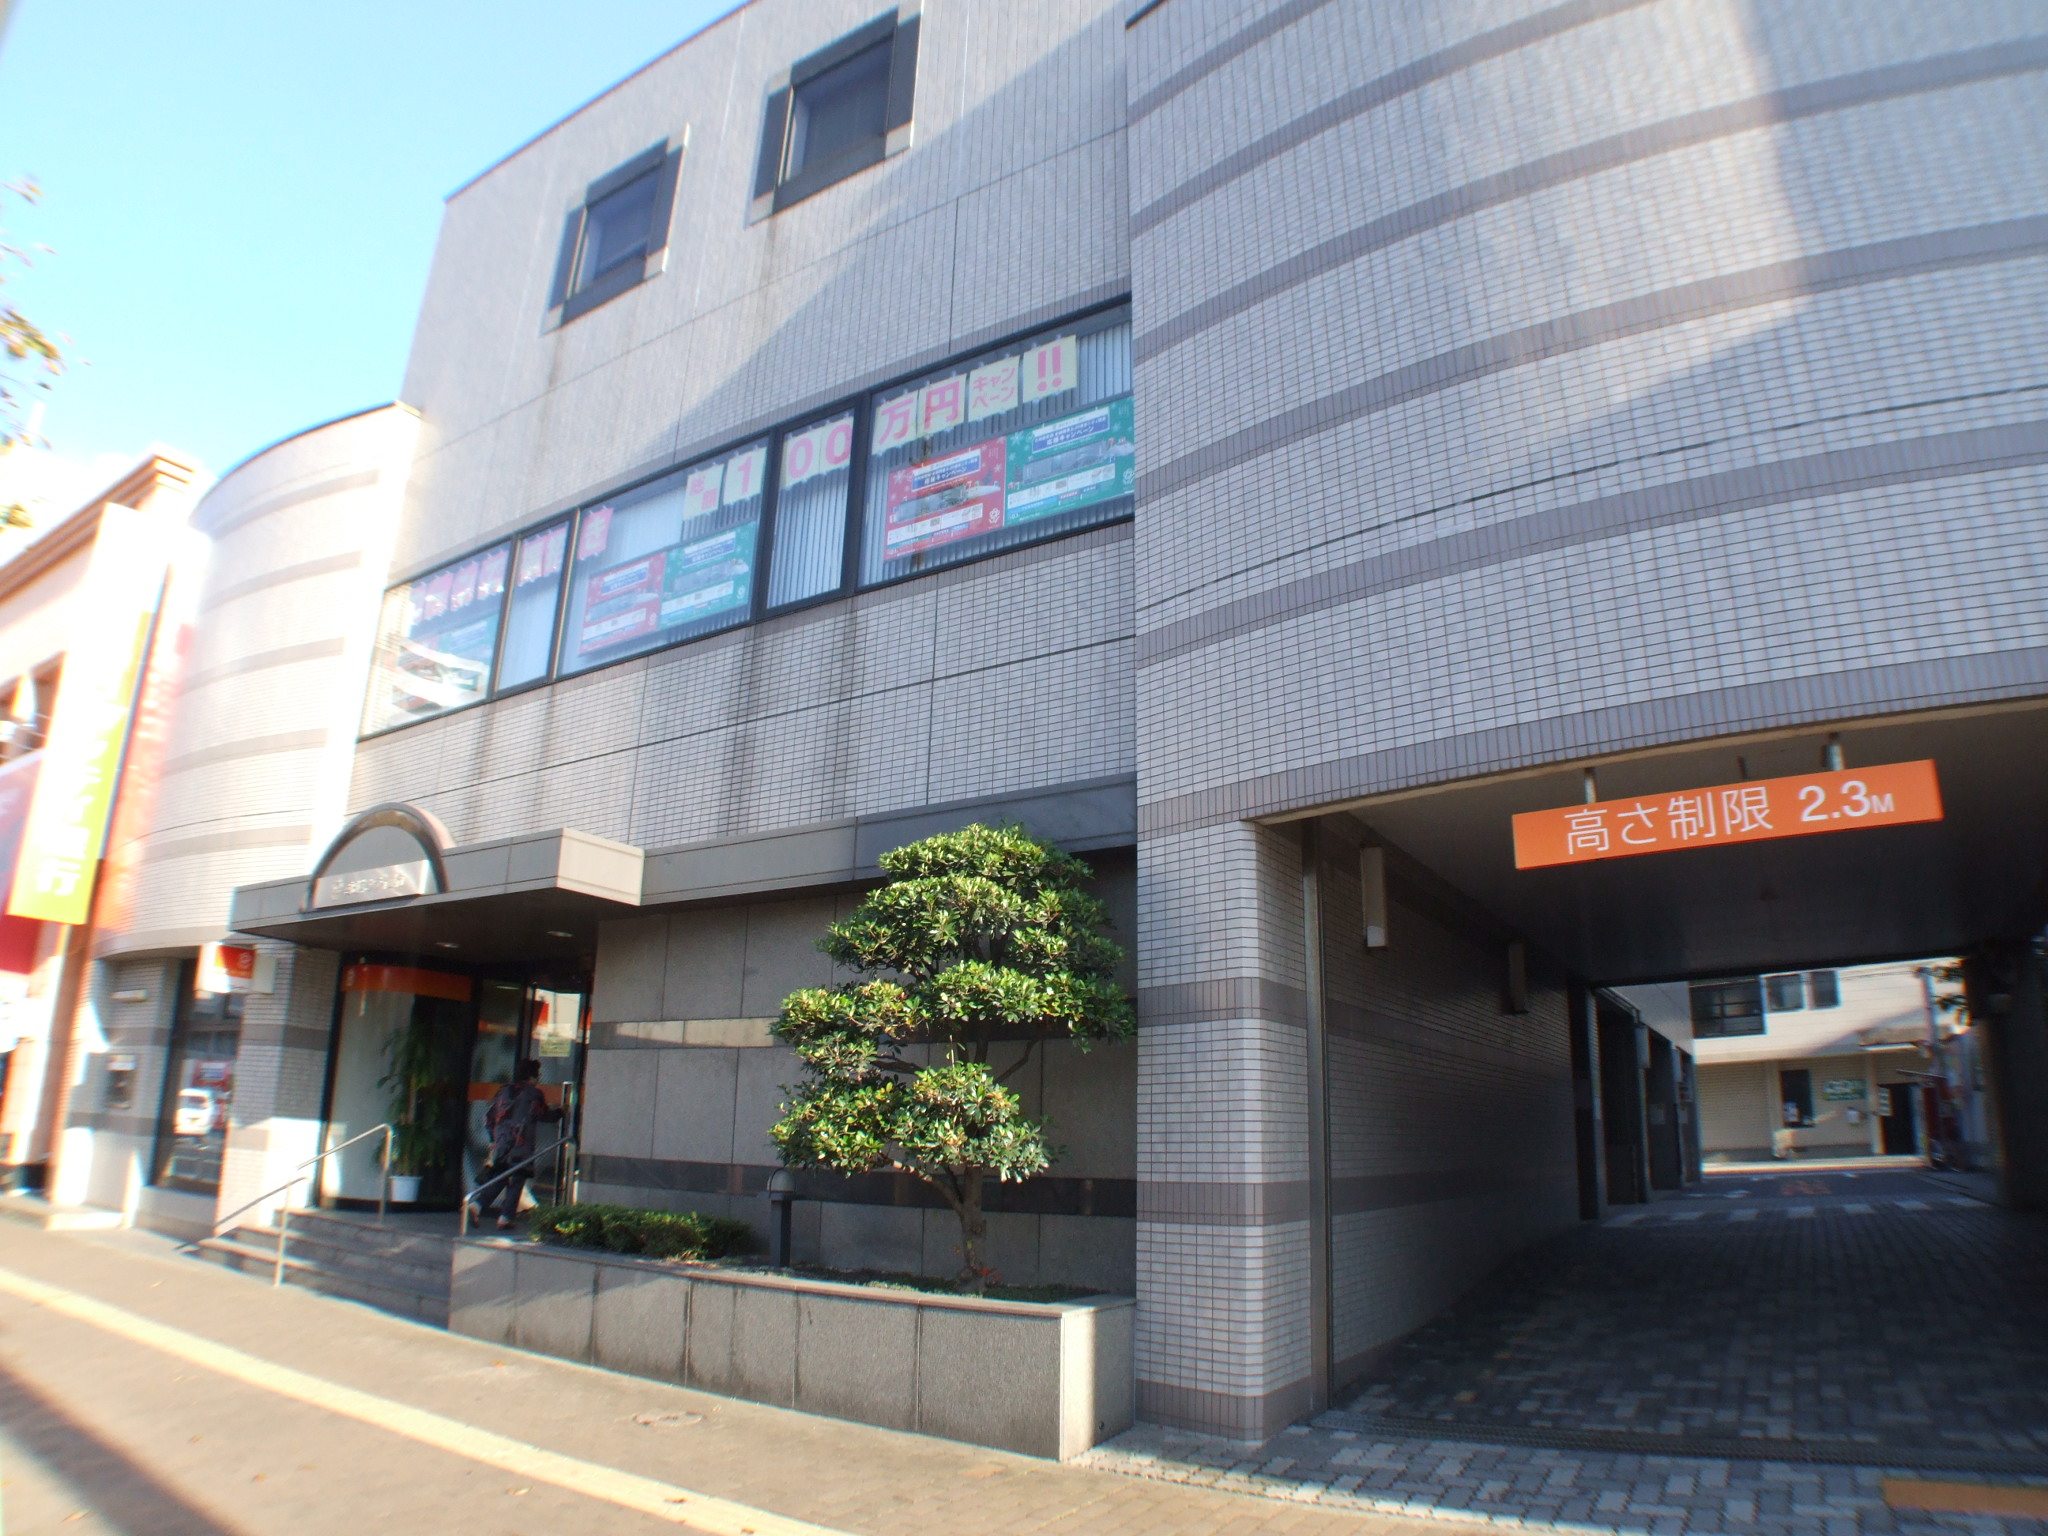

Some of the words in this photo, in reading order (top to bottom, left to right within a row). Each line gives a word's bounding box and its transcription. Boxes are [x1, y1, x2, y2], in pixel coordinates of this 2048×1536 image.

[1564, 786, 1774, 855] 高さ制限
[1798, 780, 1895, 823] 2.3M
